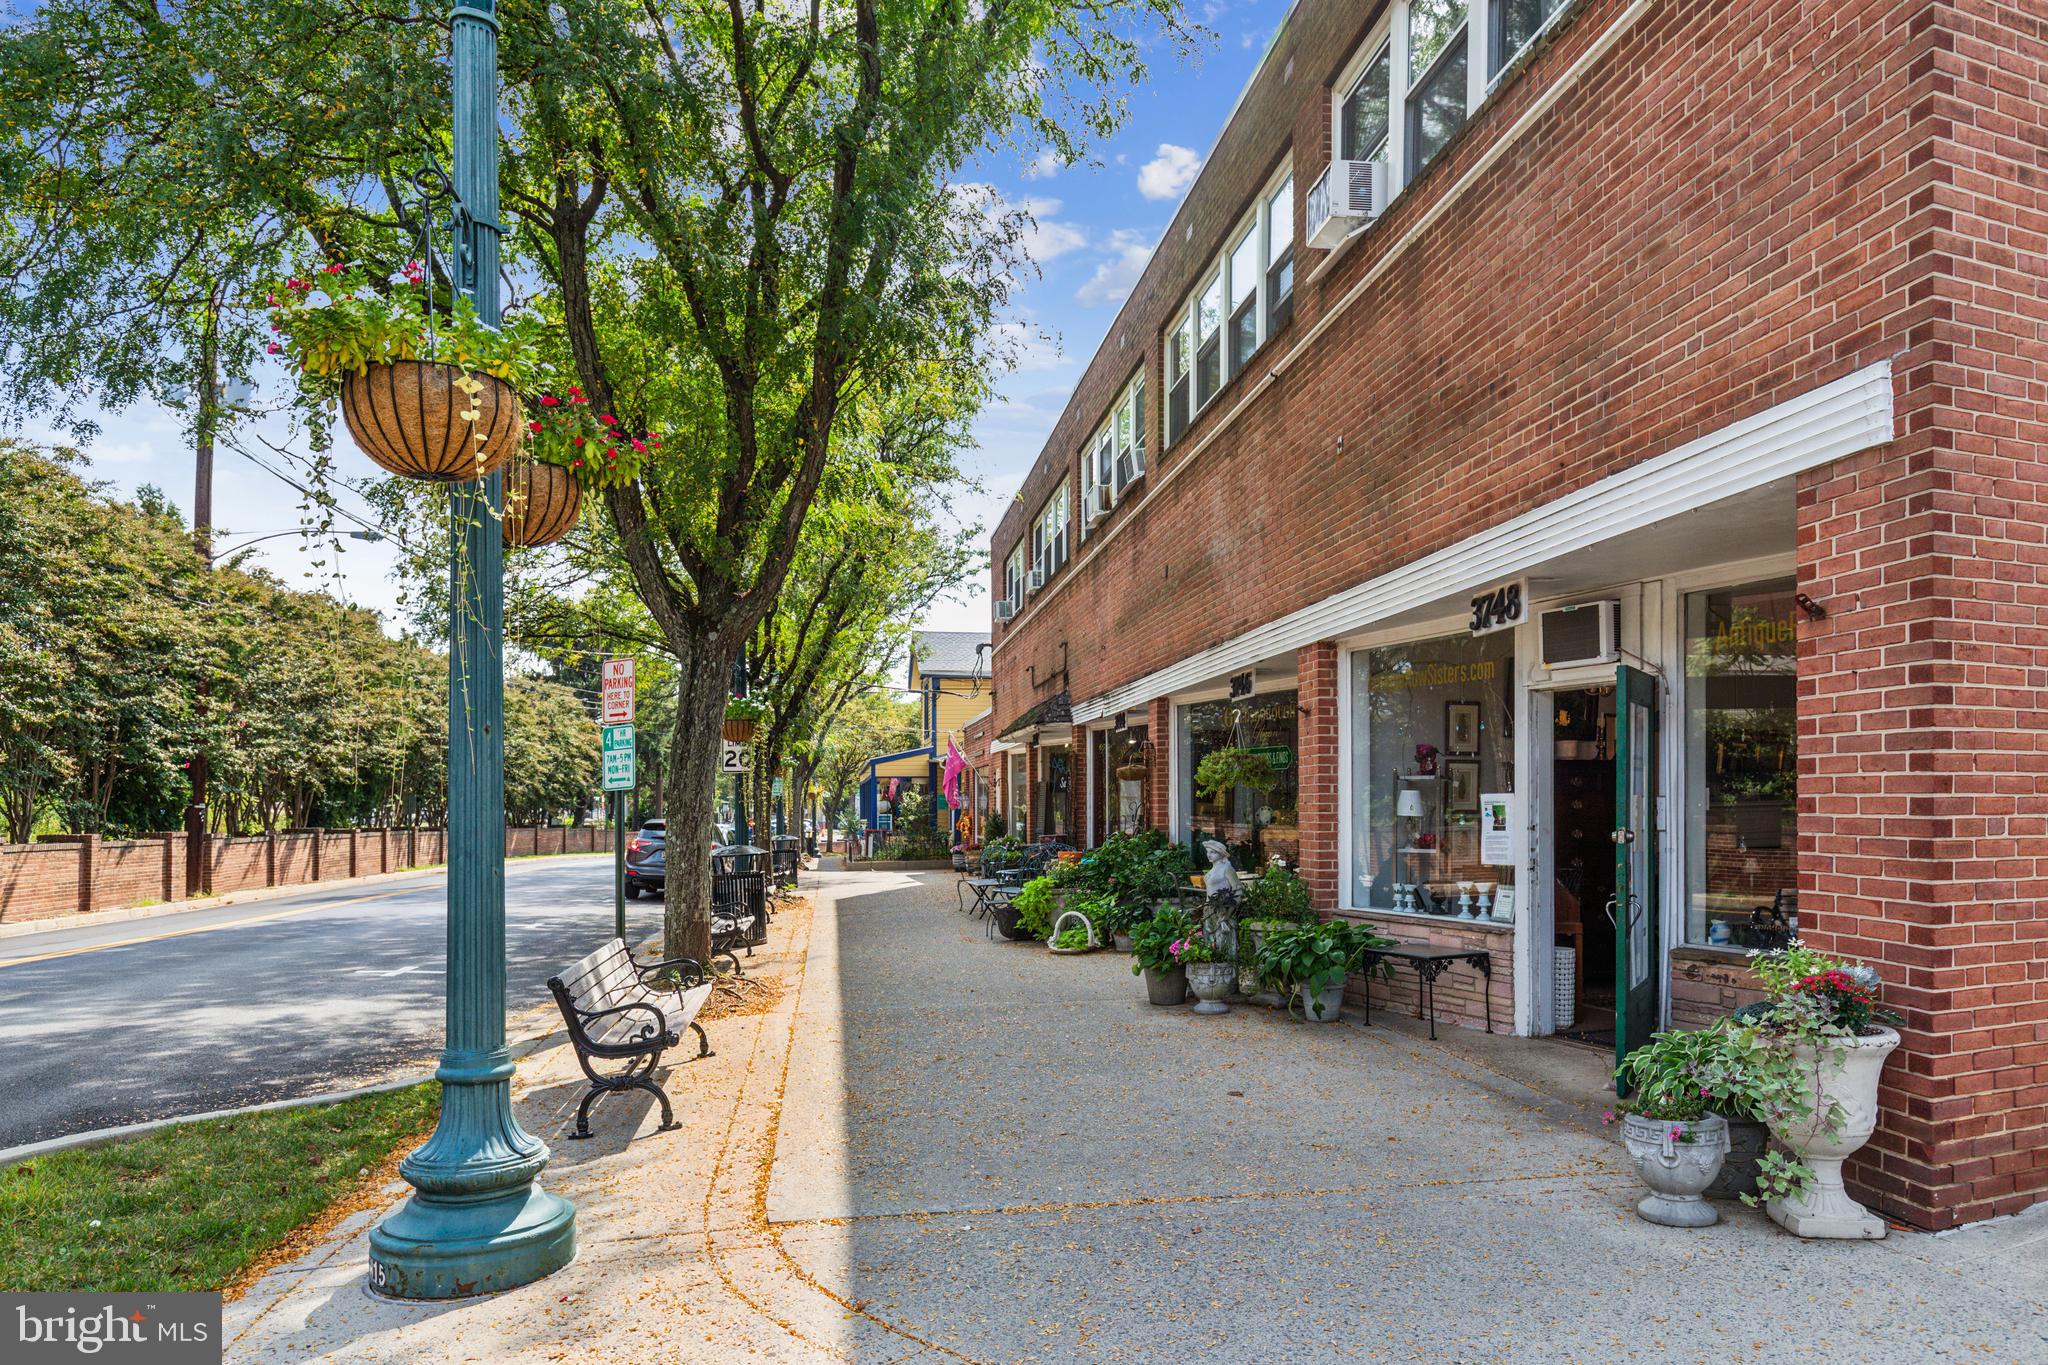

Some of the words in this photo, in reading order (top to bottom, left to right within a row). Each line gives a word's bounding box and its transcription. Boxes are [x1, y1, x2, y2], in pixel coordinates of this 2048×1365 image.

[1469, 584, 1521, 630] 3748
[613, 663, 625, 676] NO
[605, 676, 633, 690] PARKING
[607, 691, 621, 700] HERE
[623, 690, 631, 699] TO
[607, 700, 630, 710] CORNER
[605, 731, 612, 748] 4
[607, 764, 631, 774] MON-FRI
